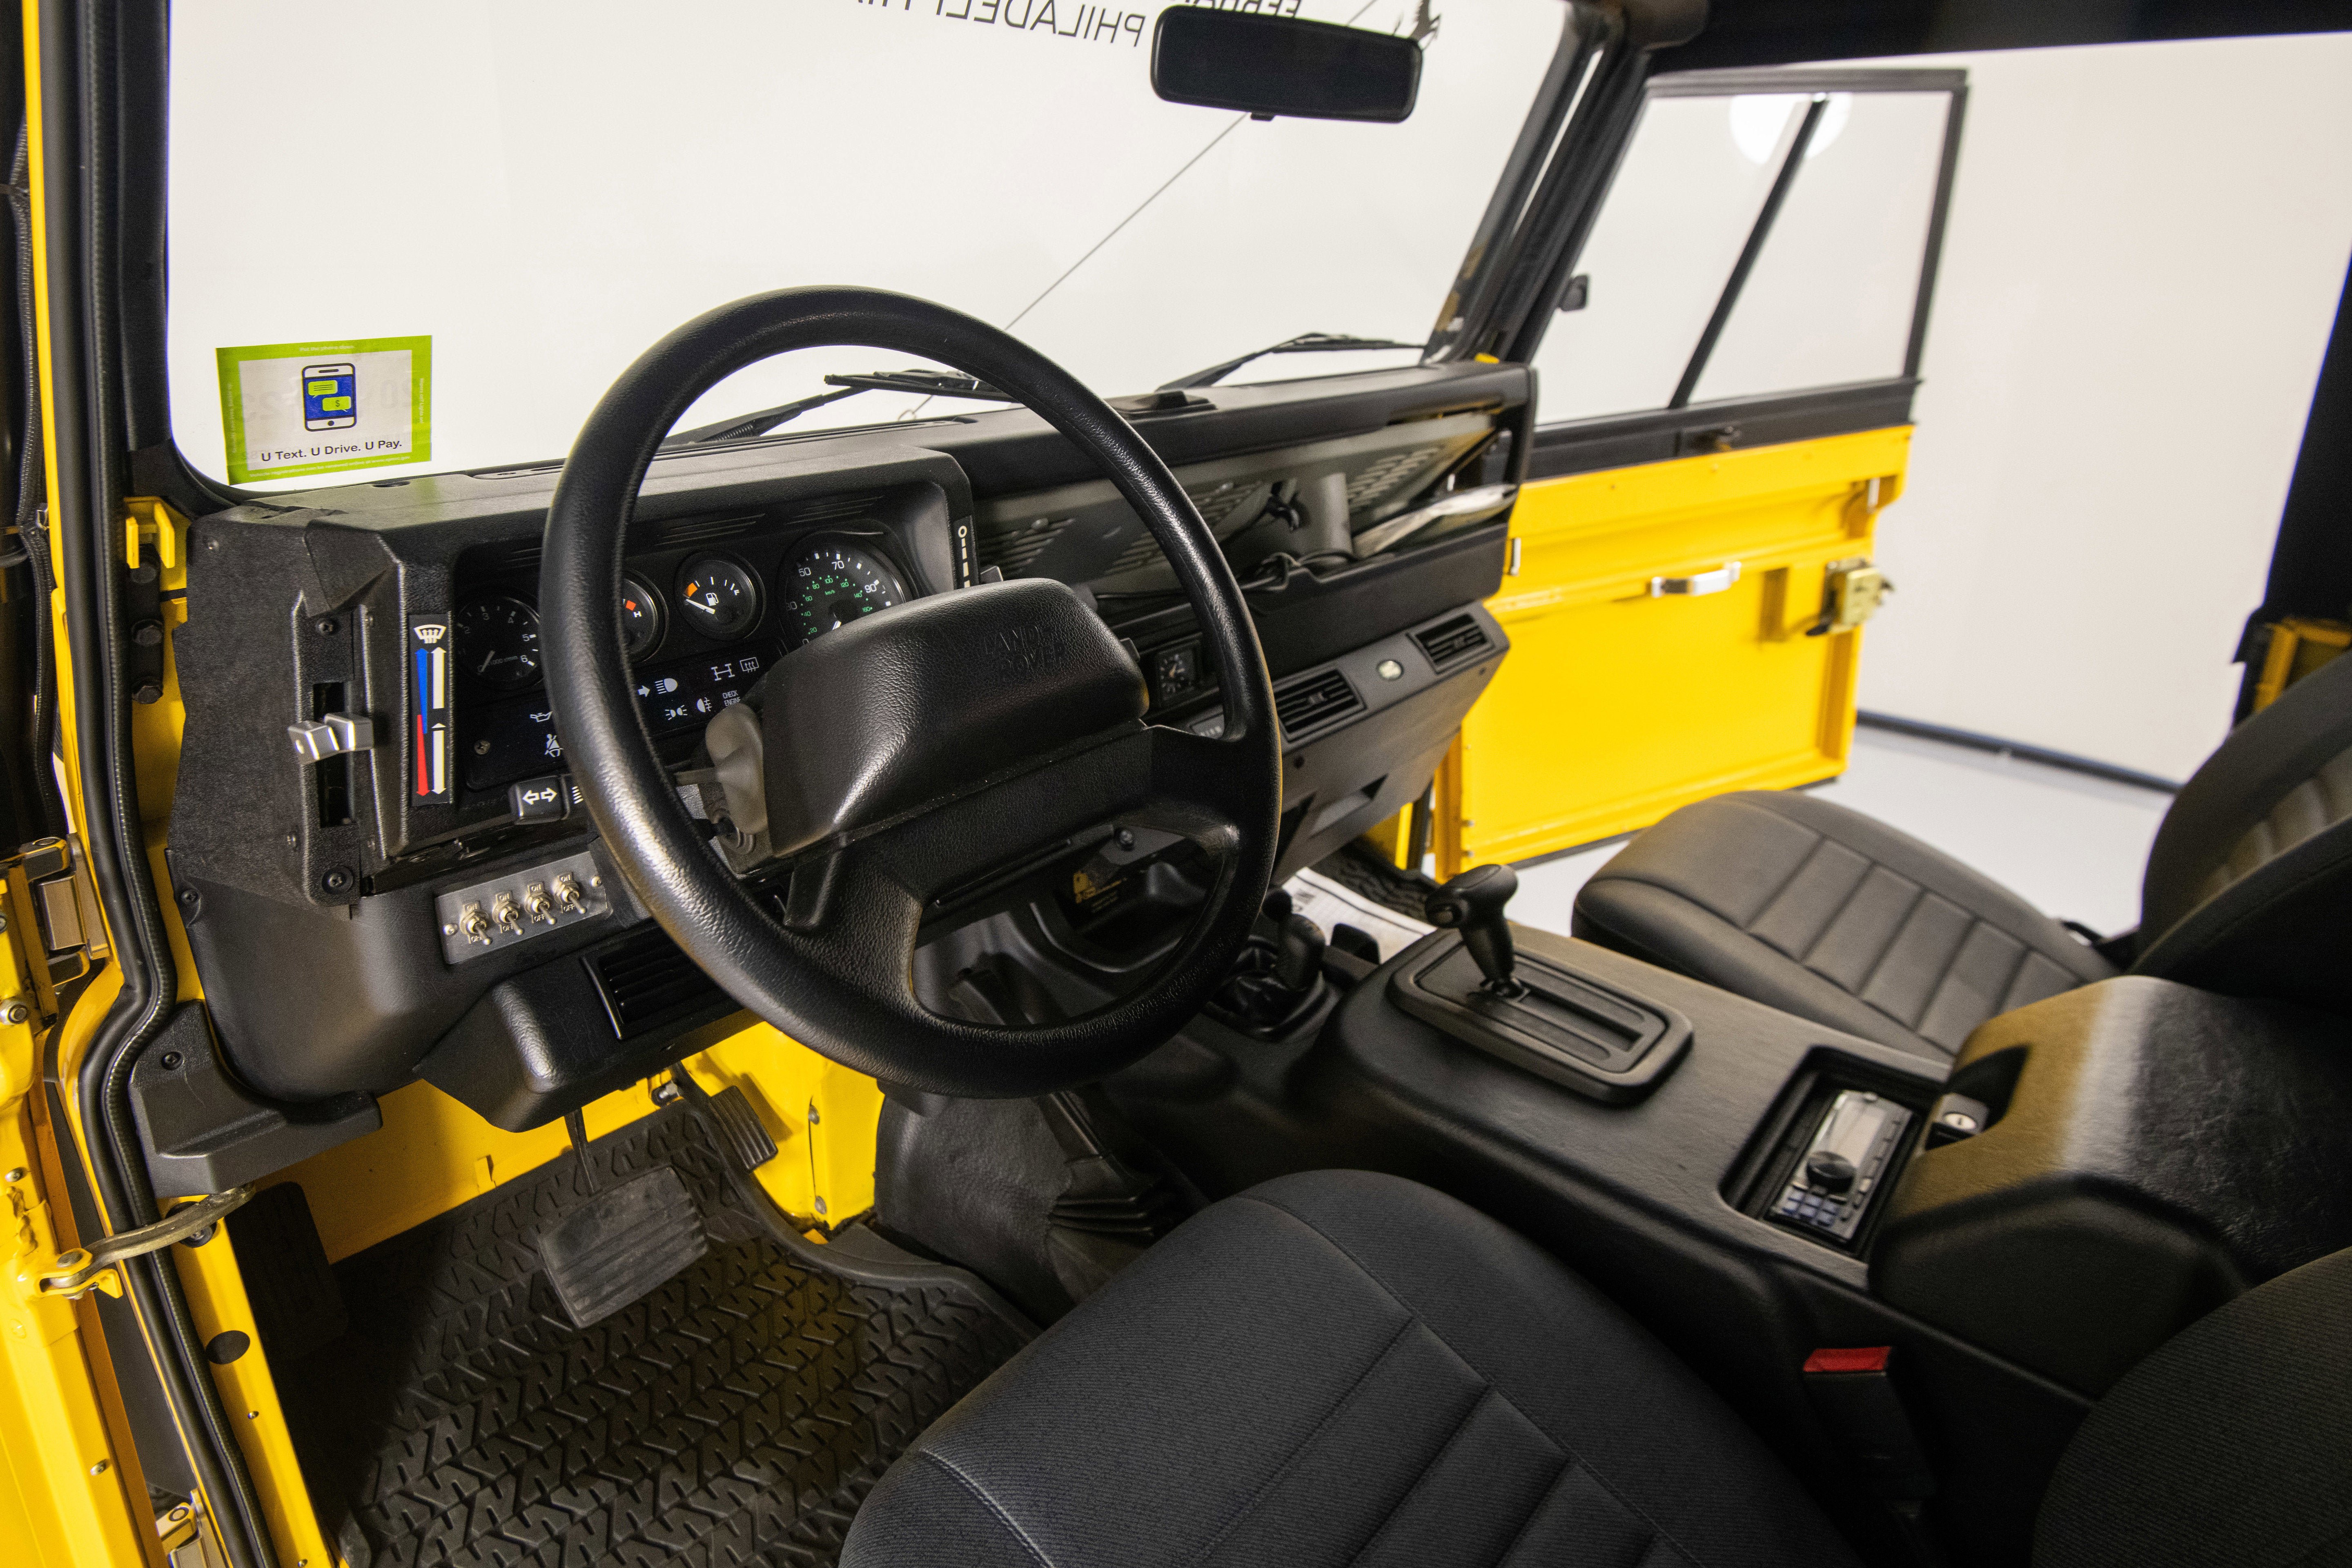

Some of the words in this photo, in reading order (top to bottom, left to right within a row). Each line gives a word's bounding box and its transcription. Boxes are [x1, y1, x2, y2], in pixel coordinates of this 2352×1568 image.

[261, 452, 271, 461] U
[275, 449, 307, 460] Text.
[311, 447, 320, 456] U
[325, 445, 361, 454] Drive.
[365, 441, 374, 450] U
[378, 440, 402, 449] Pay.
[831, 561, 844, 570] 70
[798, 567, 811, 577] 50
[864, 584, 877, 593] 90
[463, 626, 470, 634] 2
[722, 690, 738, 699] CHECK
